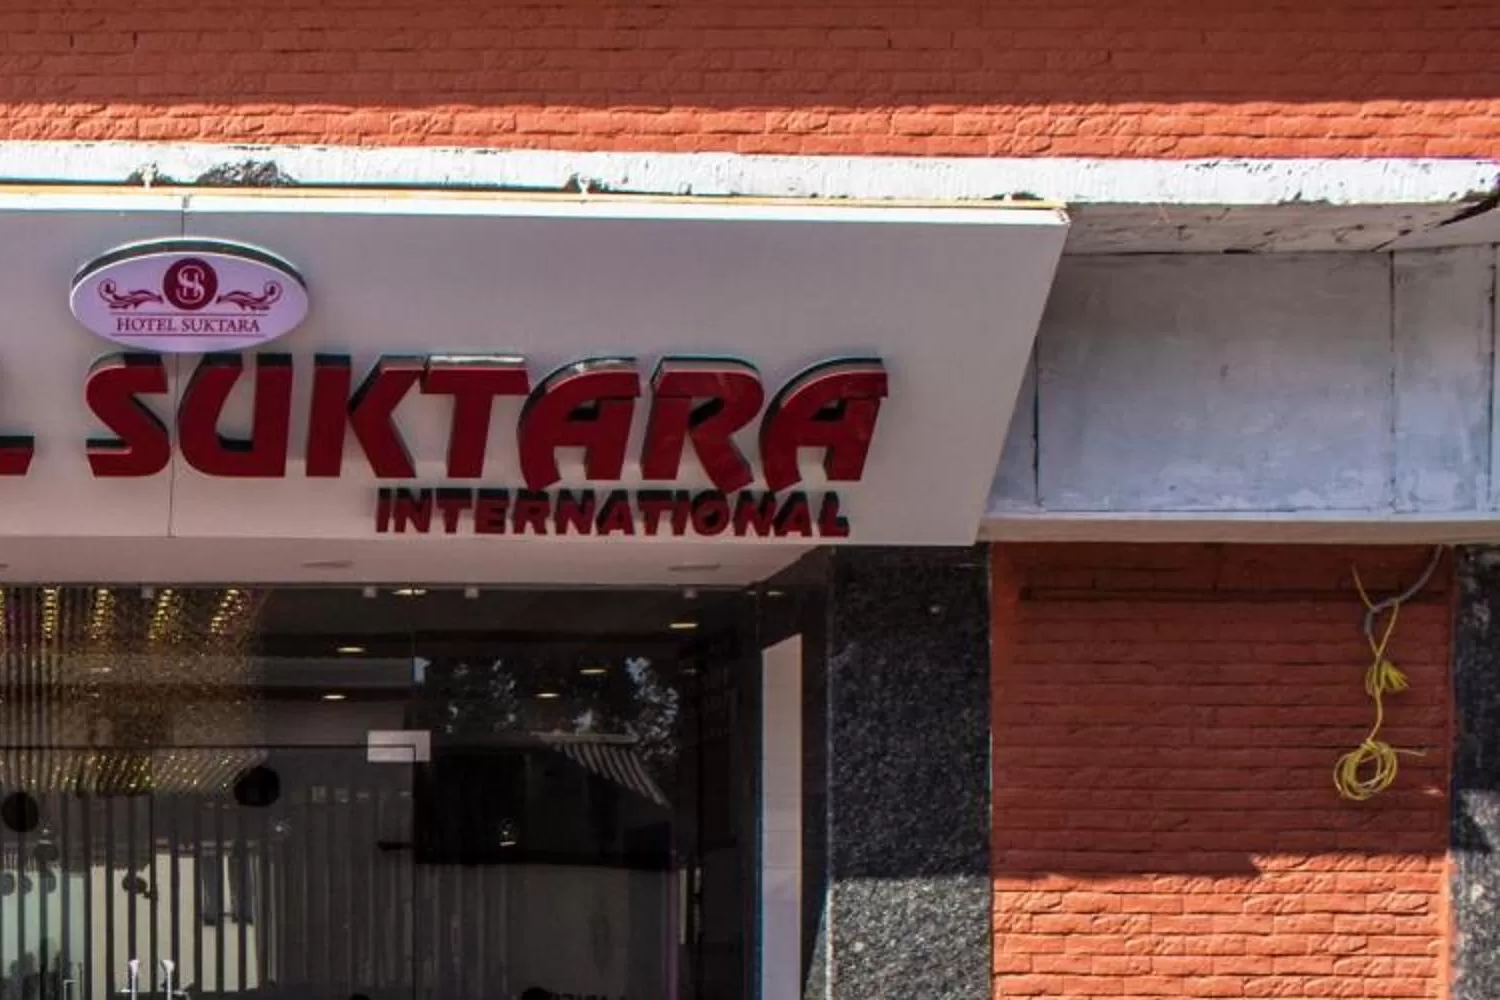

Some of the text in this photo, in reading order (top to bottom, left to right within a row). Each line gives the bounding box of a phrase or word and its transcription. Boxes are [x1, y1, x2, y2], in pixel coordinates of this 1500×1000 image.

[116, 316, 261, 334] HOTEL SUKTARA
[84, 354, 889, 494] SUKTARA
[375, 487, 850, 538] INTERNATIONAL
